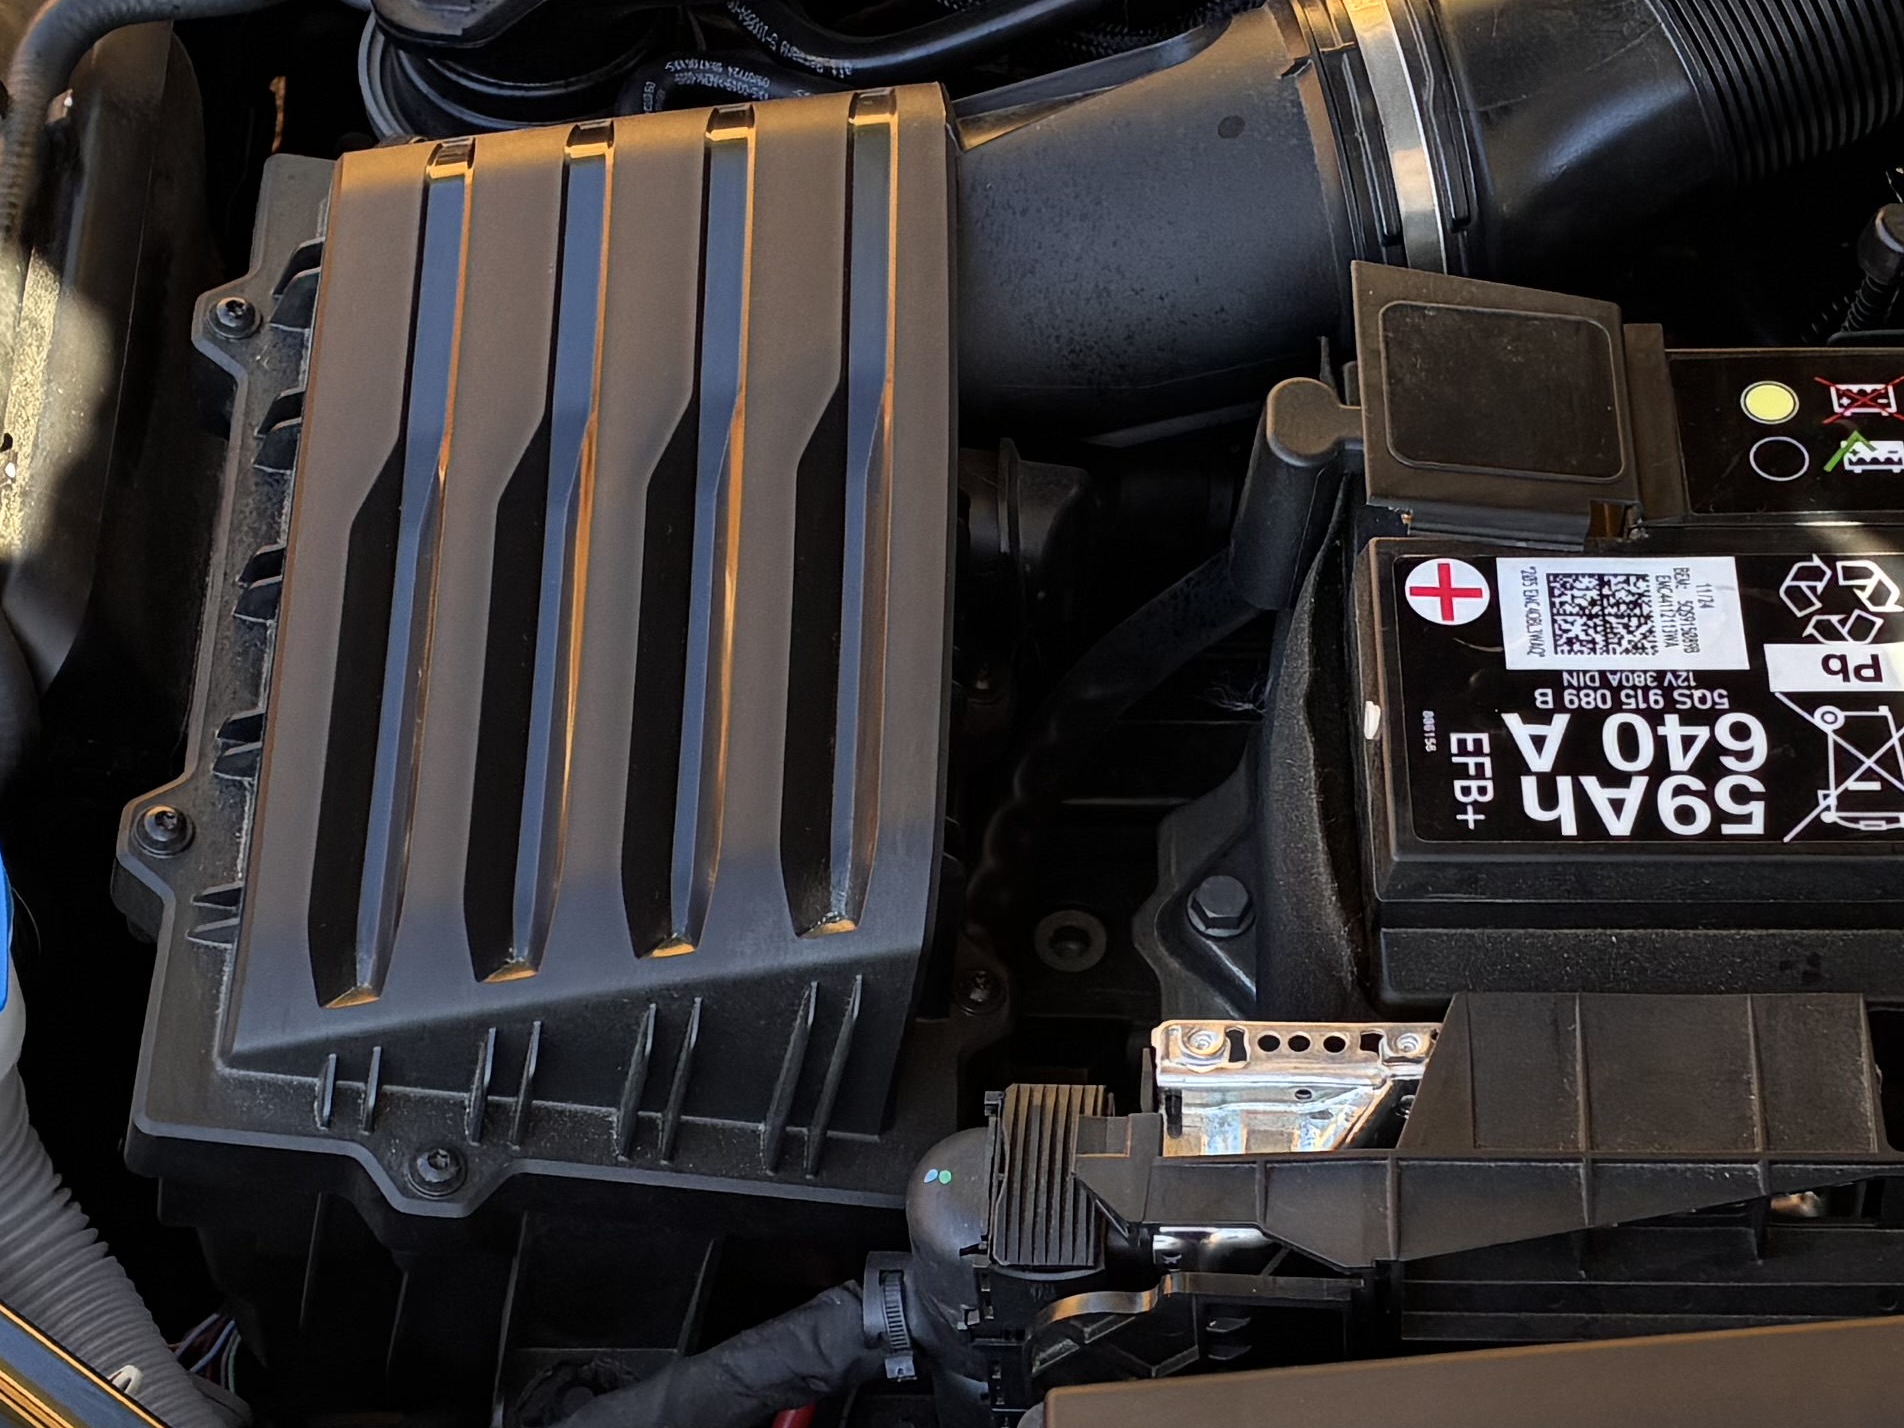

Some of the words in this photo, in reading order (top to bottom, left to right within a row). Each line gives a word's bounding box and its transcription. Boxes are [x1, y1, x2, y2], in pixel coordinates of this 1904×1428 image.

[1702, 583, 1713, 607] 11/24
[1821, 652, 1882, 682] Pb
[1562, 671, 1599, 685] DIN
[1605, 671, 1656, 685] 380A
[1664, 671, 1695, 685] 12V
[1534, 688, 1552, 708] B
[1563, 688, 1610, 708] 089
[1620, 688, 1663, 708] 915
[1672, 687, 1728, 708] 5QS
[1501, 711, 1570, 771] A
[1601, 711, 1766, 771] 640
[1450, 732, 1494, 830] EFB+
[1522, 771, 1766, 836] 59Ah
